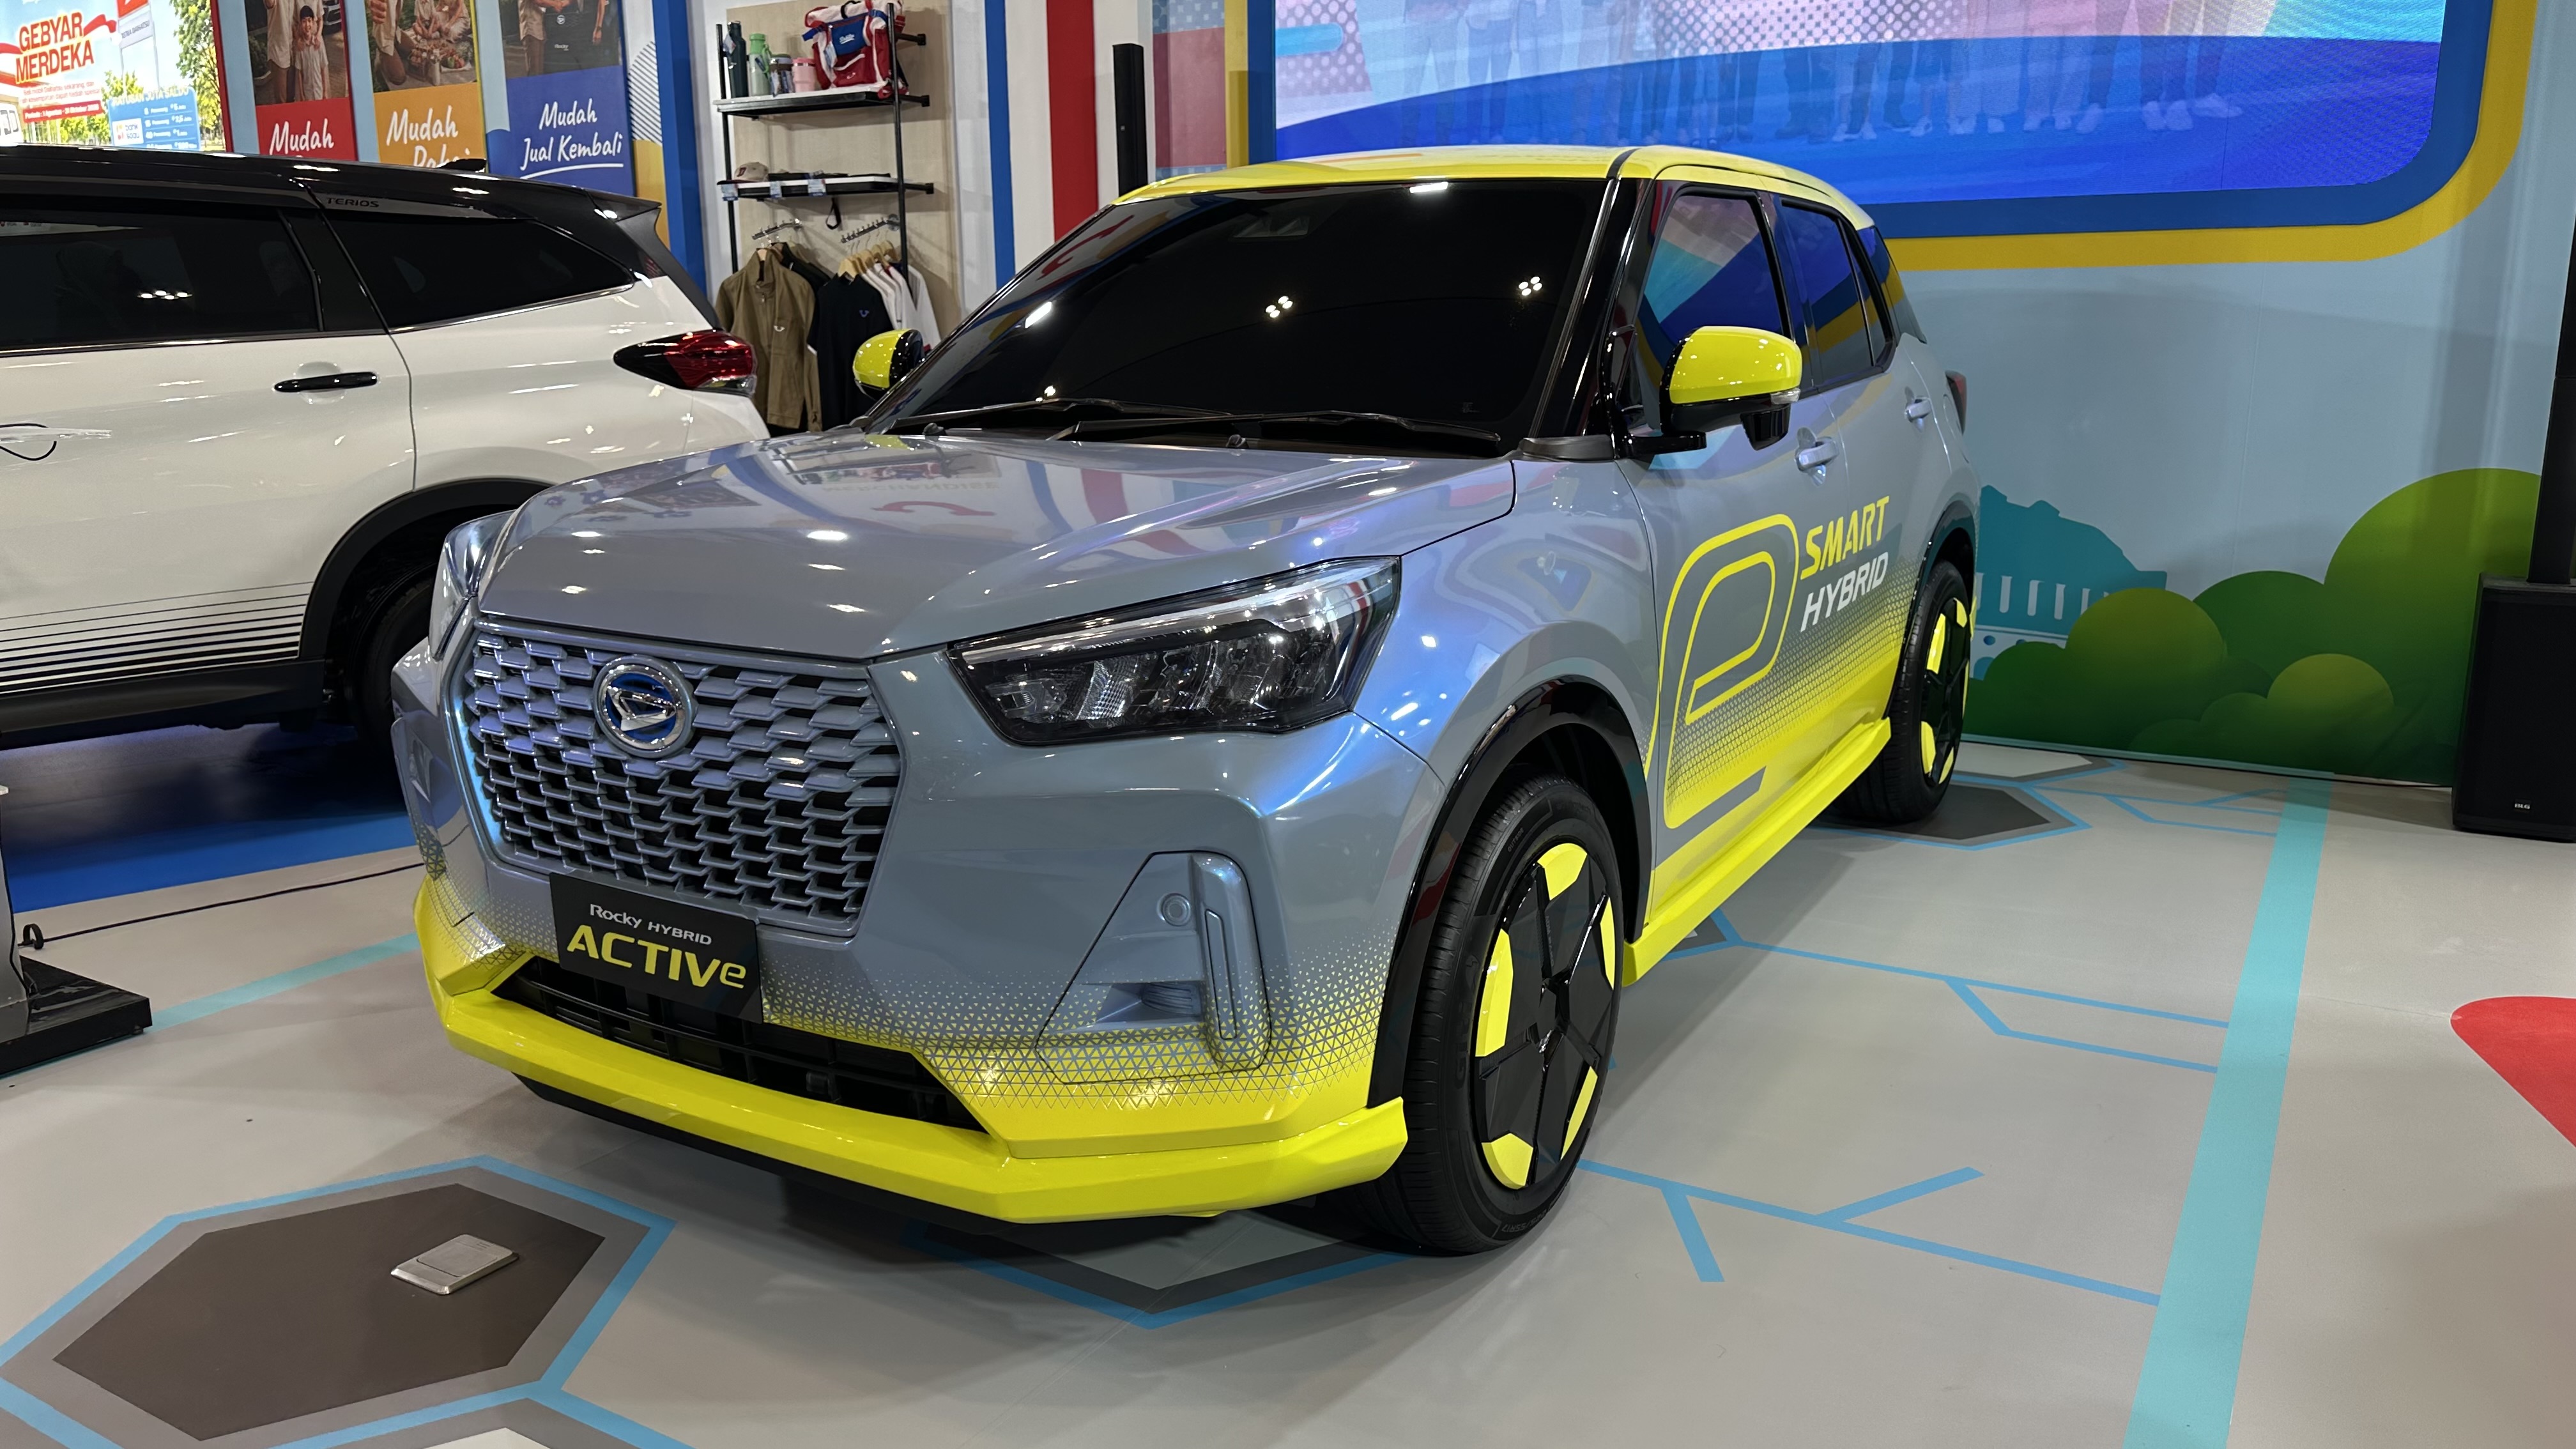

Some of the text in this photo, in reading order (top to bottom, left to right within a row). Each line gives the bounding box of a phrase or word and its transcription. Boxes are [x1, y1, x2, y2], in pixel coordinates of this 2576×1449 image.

[19, 12, 84, 52] GEBYAR
[15, 38, 95, 84] MERDEKA
[386, 105, 459, 146] Mudah
[539, 98, 597, 130] Mudah
[270, 118, 334, 155] Mudah
[520, 131, 623, 171] Jual Kembali
[326, 197, 379, 208] TERIOS
[1800, 496, 1890, 580] SMART
[1800, 551, 1889, 632] HYBRID
[590, 903, 712, 945] Rocky HYBRID
